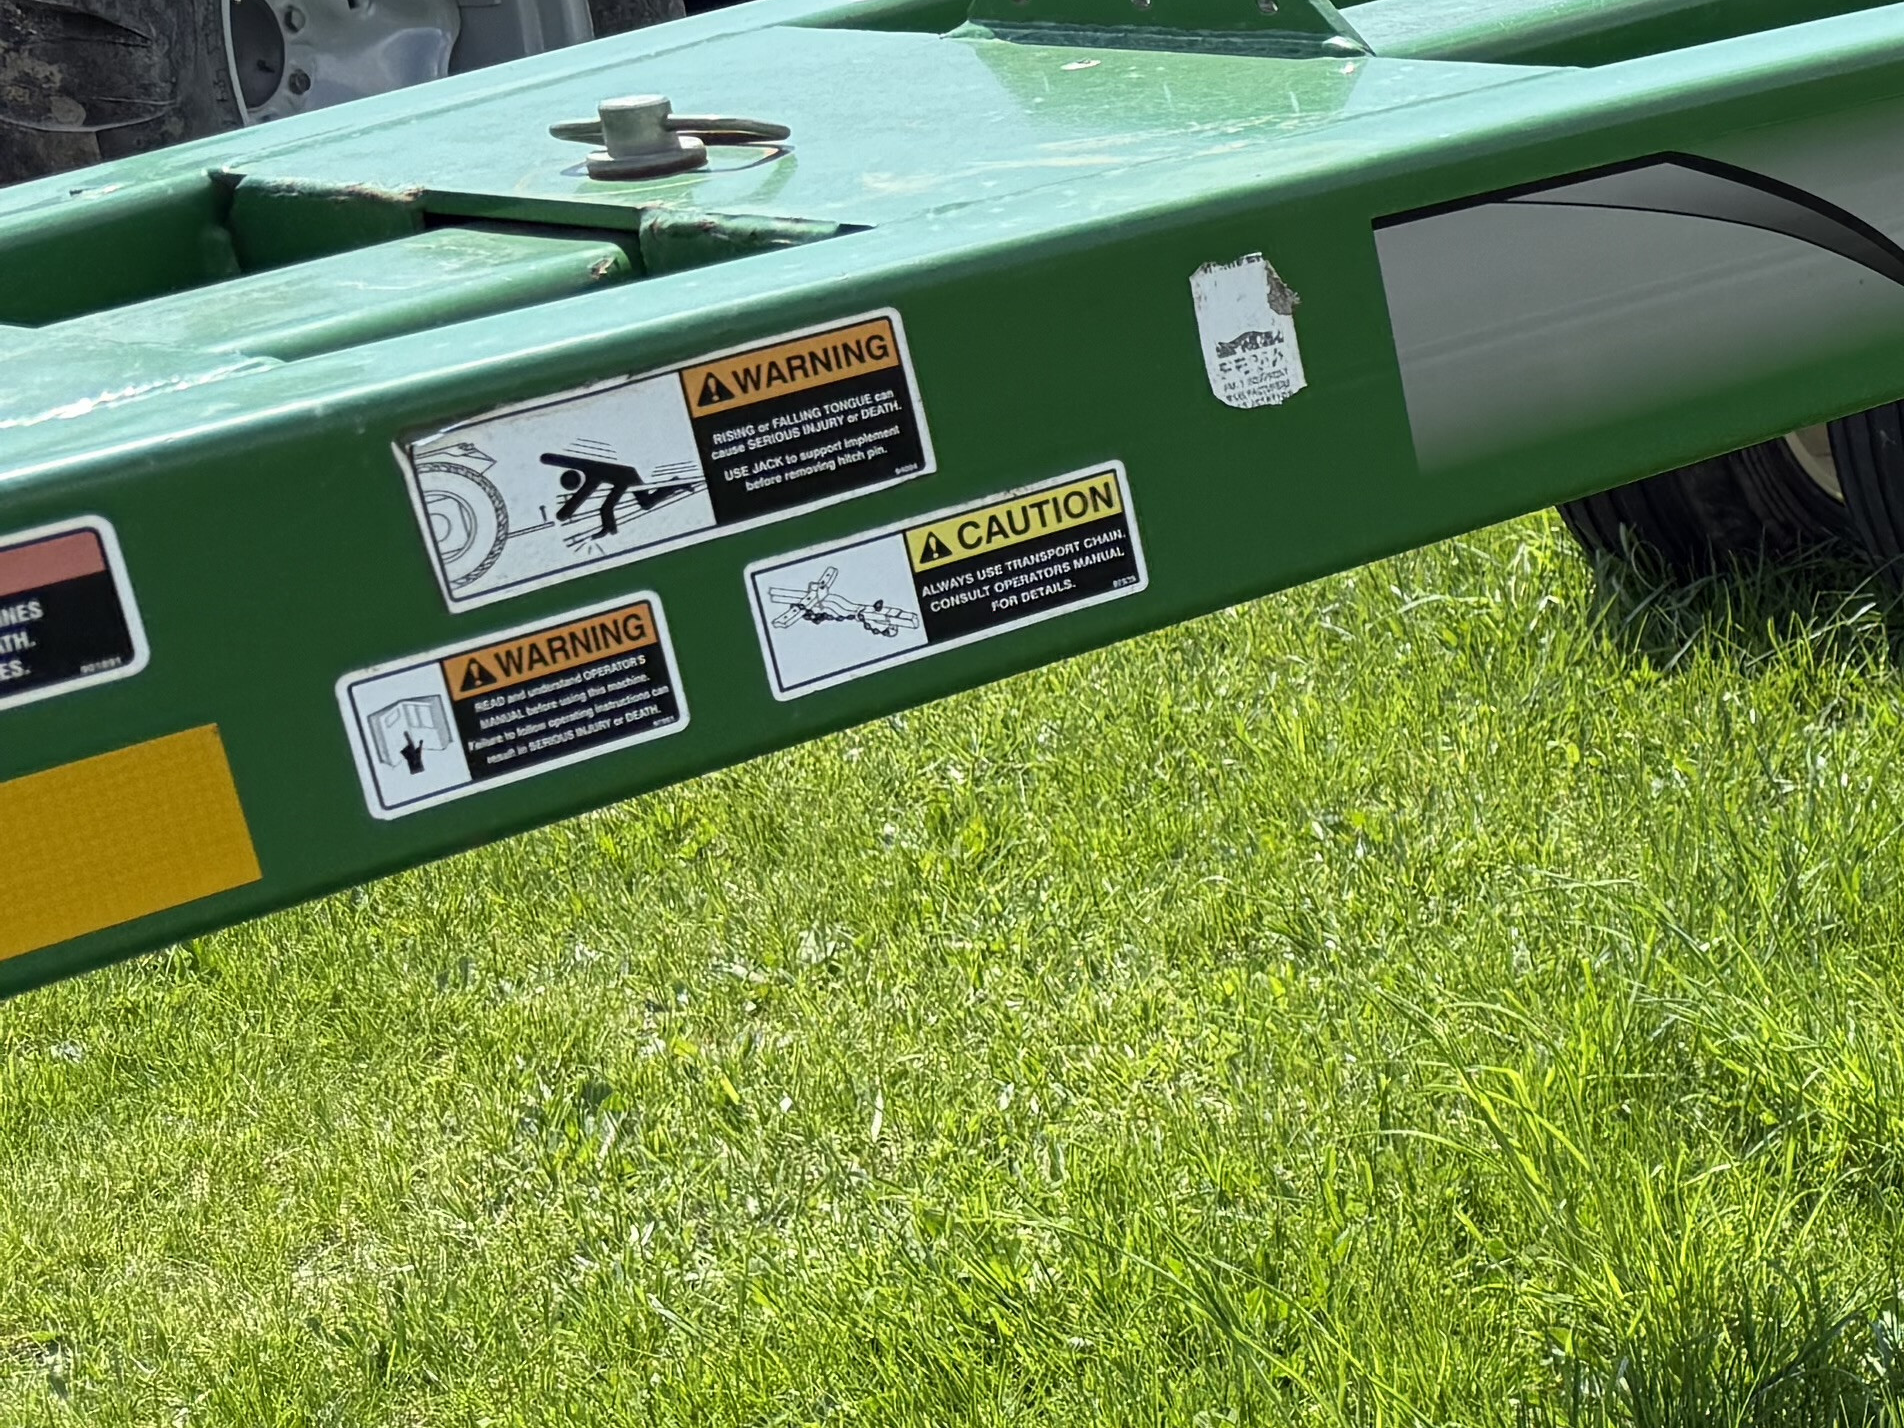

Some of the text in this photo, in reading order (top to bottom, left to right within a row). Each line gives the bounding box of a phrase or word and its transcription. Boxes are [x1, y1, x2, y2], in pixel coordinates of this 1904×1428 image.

[732, 335, 889, 394] WARNING
[711, 403, 902, 460] cause SERIOUS INJURY or DEATH.
[713, 390, 894, 445] RISING or FALLING TONGUE can
[724, 426, 900, 482] USE JACK to support implement
[746, 445, 888, 491] before removing hitch pin.
[957, 481, 1114, 550] CAUTION
[921, 529, 1126, 598] ALWAYS USE TRANSPORT CHAIN.
[930, 547, 1125, 613] CONSULT OPERATORS MANUAL
[991, 579, 1077, 612] FOR DETAILS.
[495, 613, 647, 678] WARNING
[468, 685, 670, 752] Failure to follow operating instructions can
[475, 696, 506, 714] READ
[507, 690, 526, 704] and
[527, 675, 582, 699] understand
[480, 709, 525, 731] MANUAL
[526, 700, 558, 717] before
[559, 693, 587, 709] using
[588, 684, 607, 699] this
[487, 749, 516, 765] result
[517, 744, 528, 755] in
[529, 730, 575, 752] SERIOUS
[576, 718, 612, 738] INJURY
[613, 716, 624, 727] or
[624, 705, 662, 723] DEATH.
